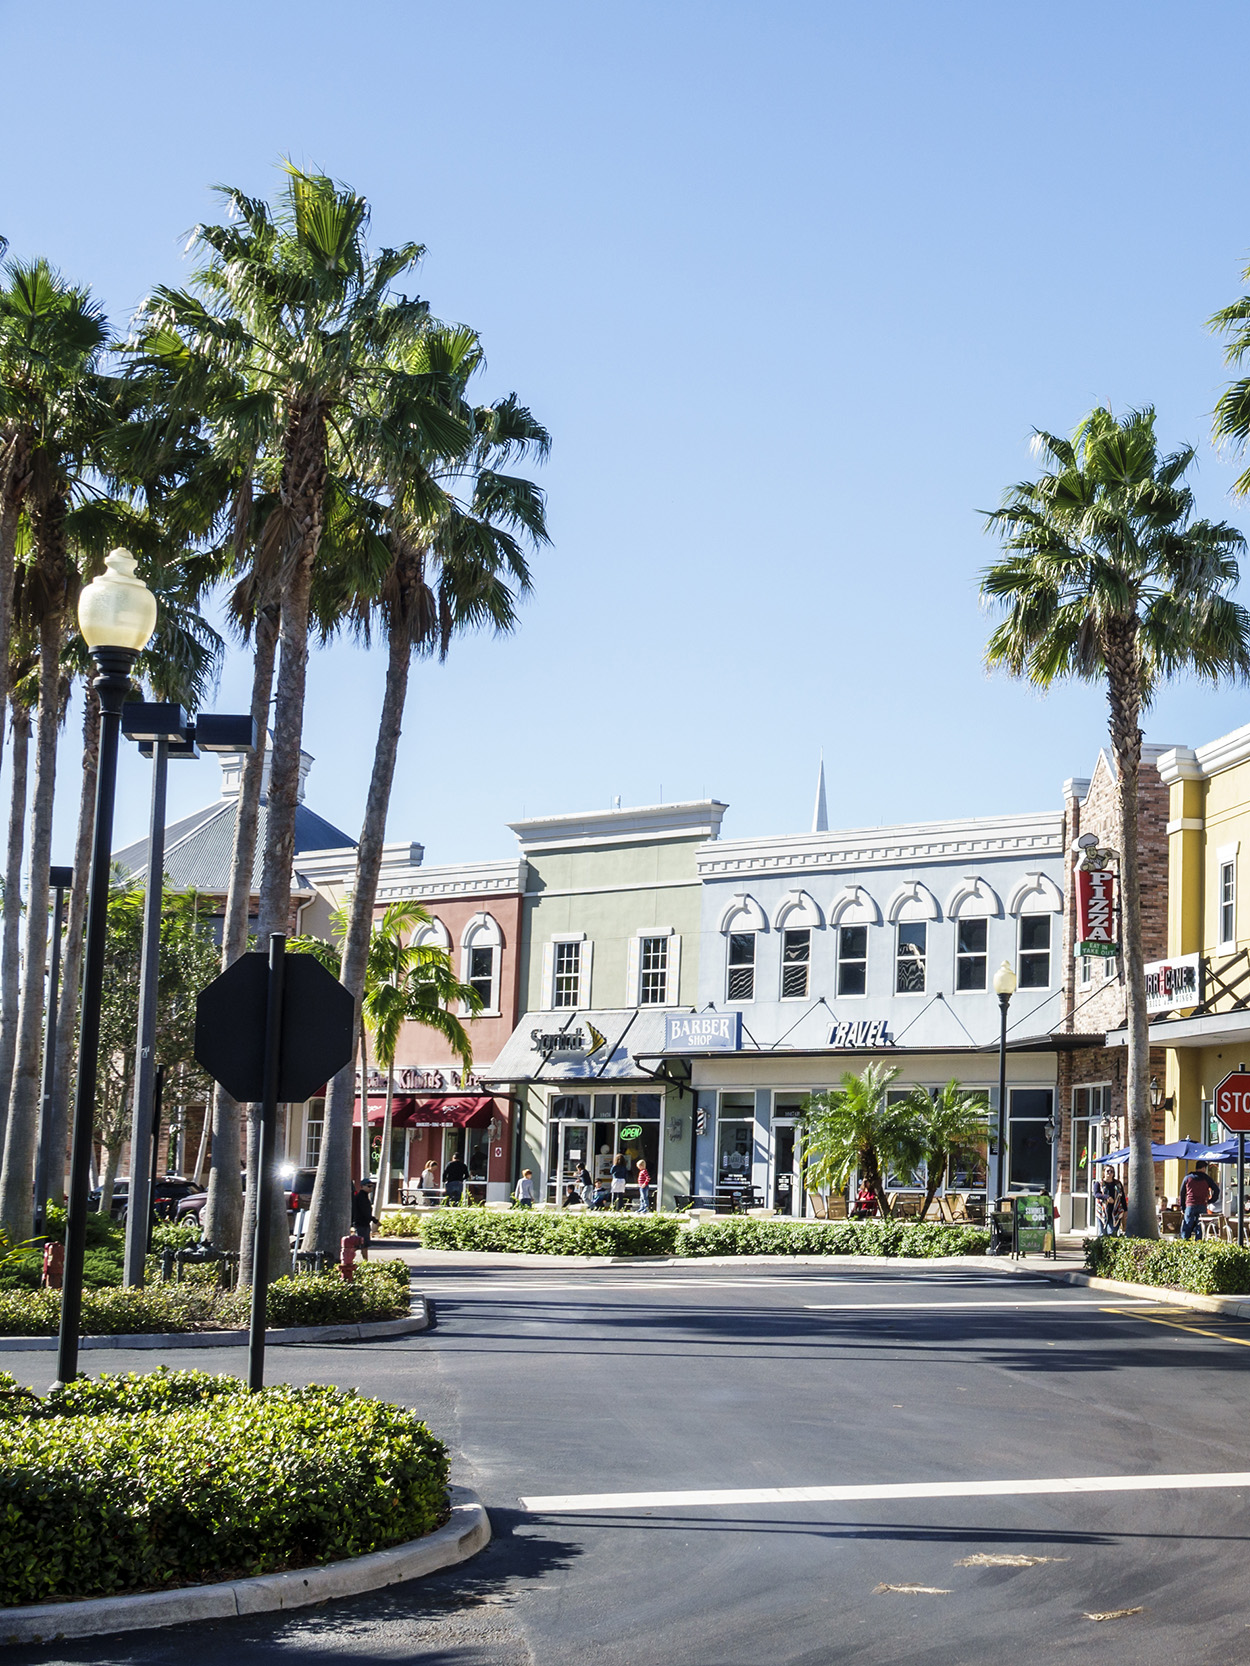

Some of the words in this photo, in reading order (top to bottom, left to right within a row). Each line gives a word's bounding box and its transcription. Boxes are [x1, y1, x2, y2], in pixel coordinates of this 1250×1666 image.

[1085, 872, 1113, 941] PIZZA
[671, 1018, 731, 1040] BARBER
[688, 1034, 713, 1046] SHOP
[826, 1020, 889, 1046] TRAVEL
[530, 1026, 585, 1058] Sprint
[621, 1127, 640, 1138] OPEN
